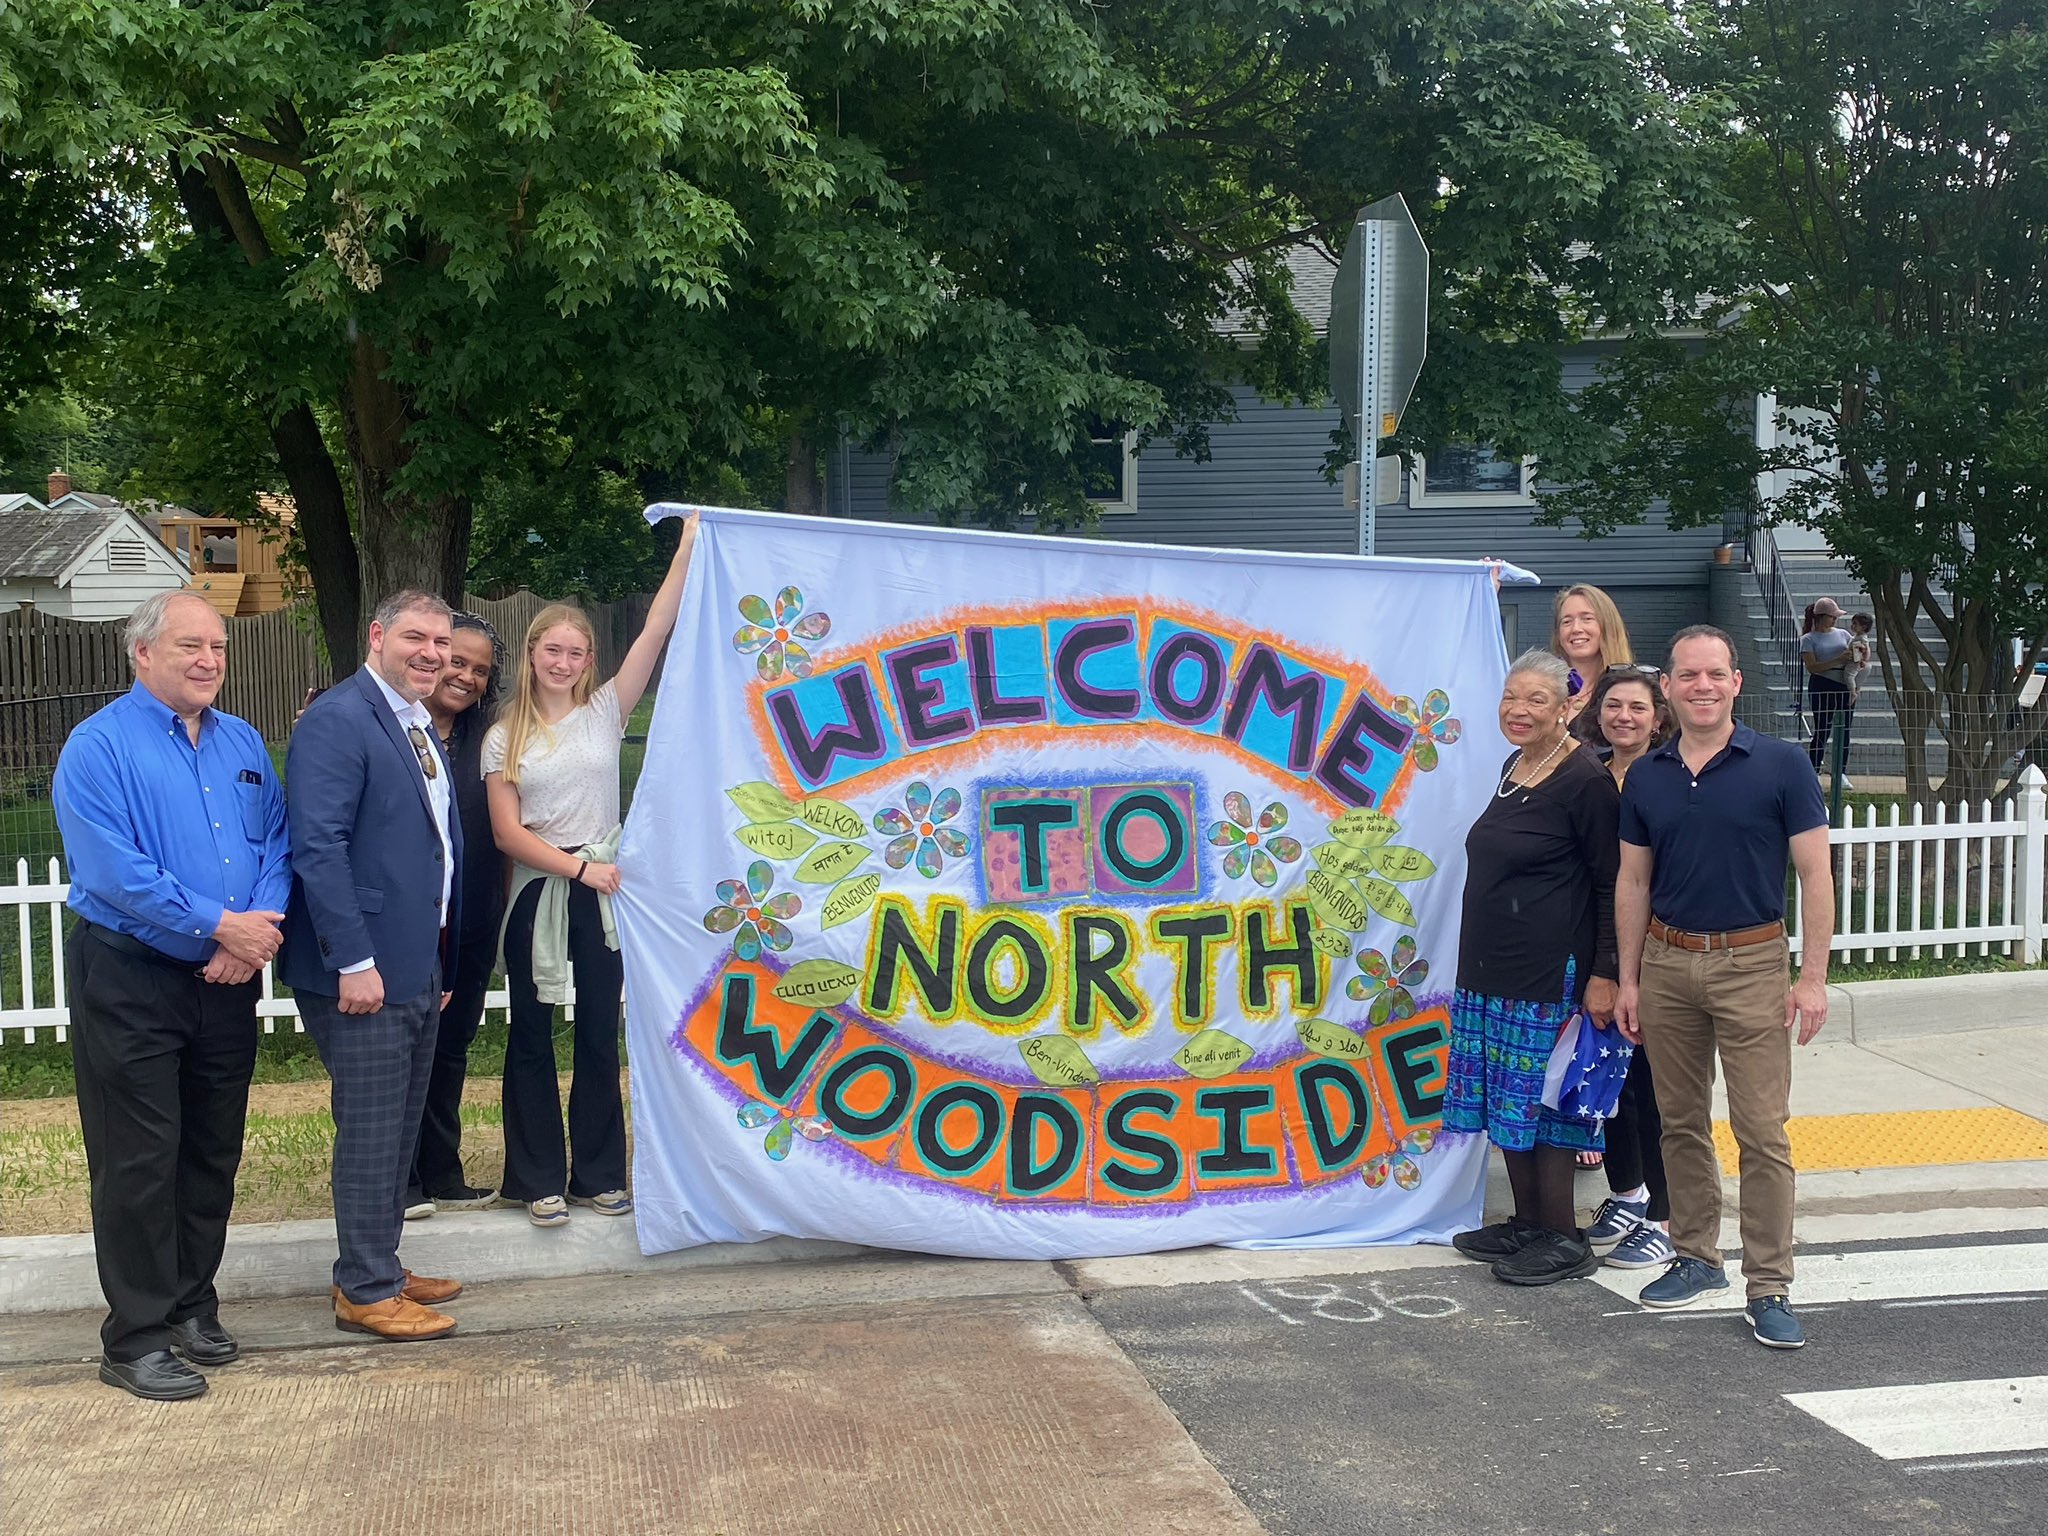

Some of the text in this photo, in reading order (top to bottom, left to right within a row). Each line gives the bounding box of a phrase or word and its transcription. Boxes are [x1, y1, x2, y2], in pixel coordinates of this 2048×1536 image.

[764, 619, 1415, 809] WELCOME
[747, 828, 794, 851] witaj
[803, 800, 864, 837] WELKOM
[989, 789, 1189, 893] TO
[823, 874, 880, 922] BENVENUTO
[1308, 870, 1367, 930] BIENVENIDOS
[866, 900, 1324, 1031] NORTH
[713, 973, 1449, 1198] WOODSIDE
[1184, 1048, 1203, 1064] Bine
[1218, 1047, 1242, 1061] venit
